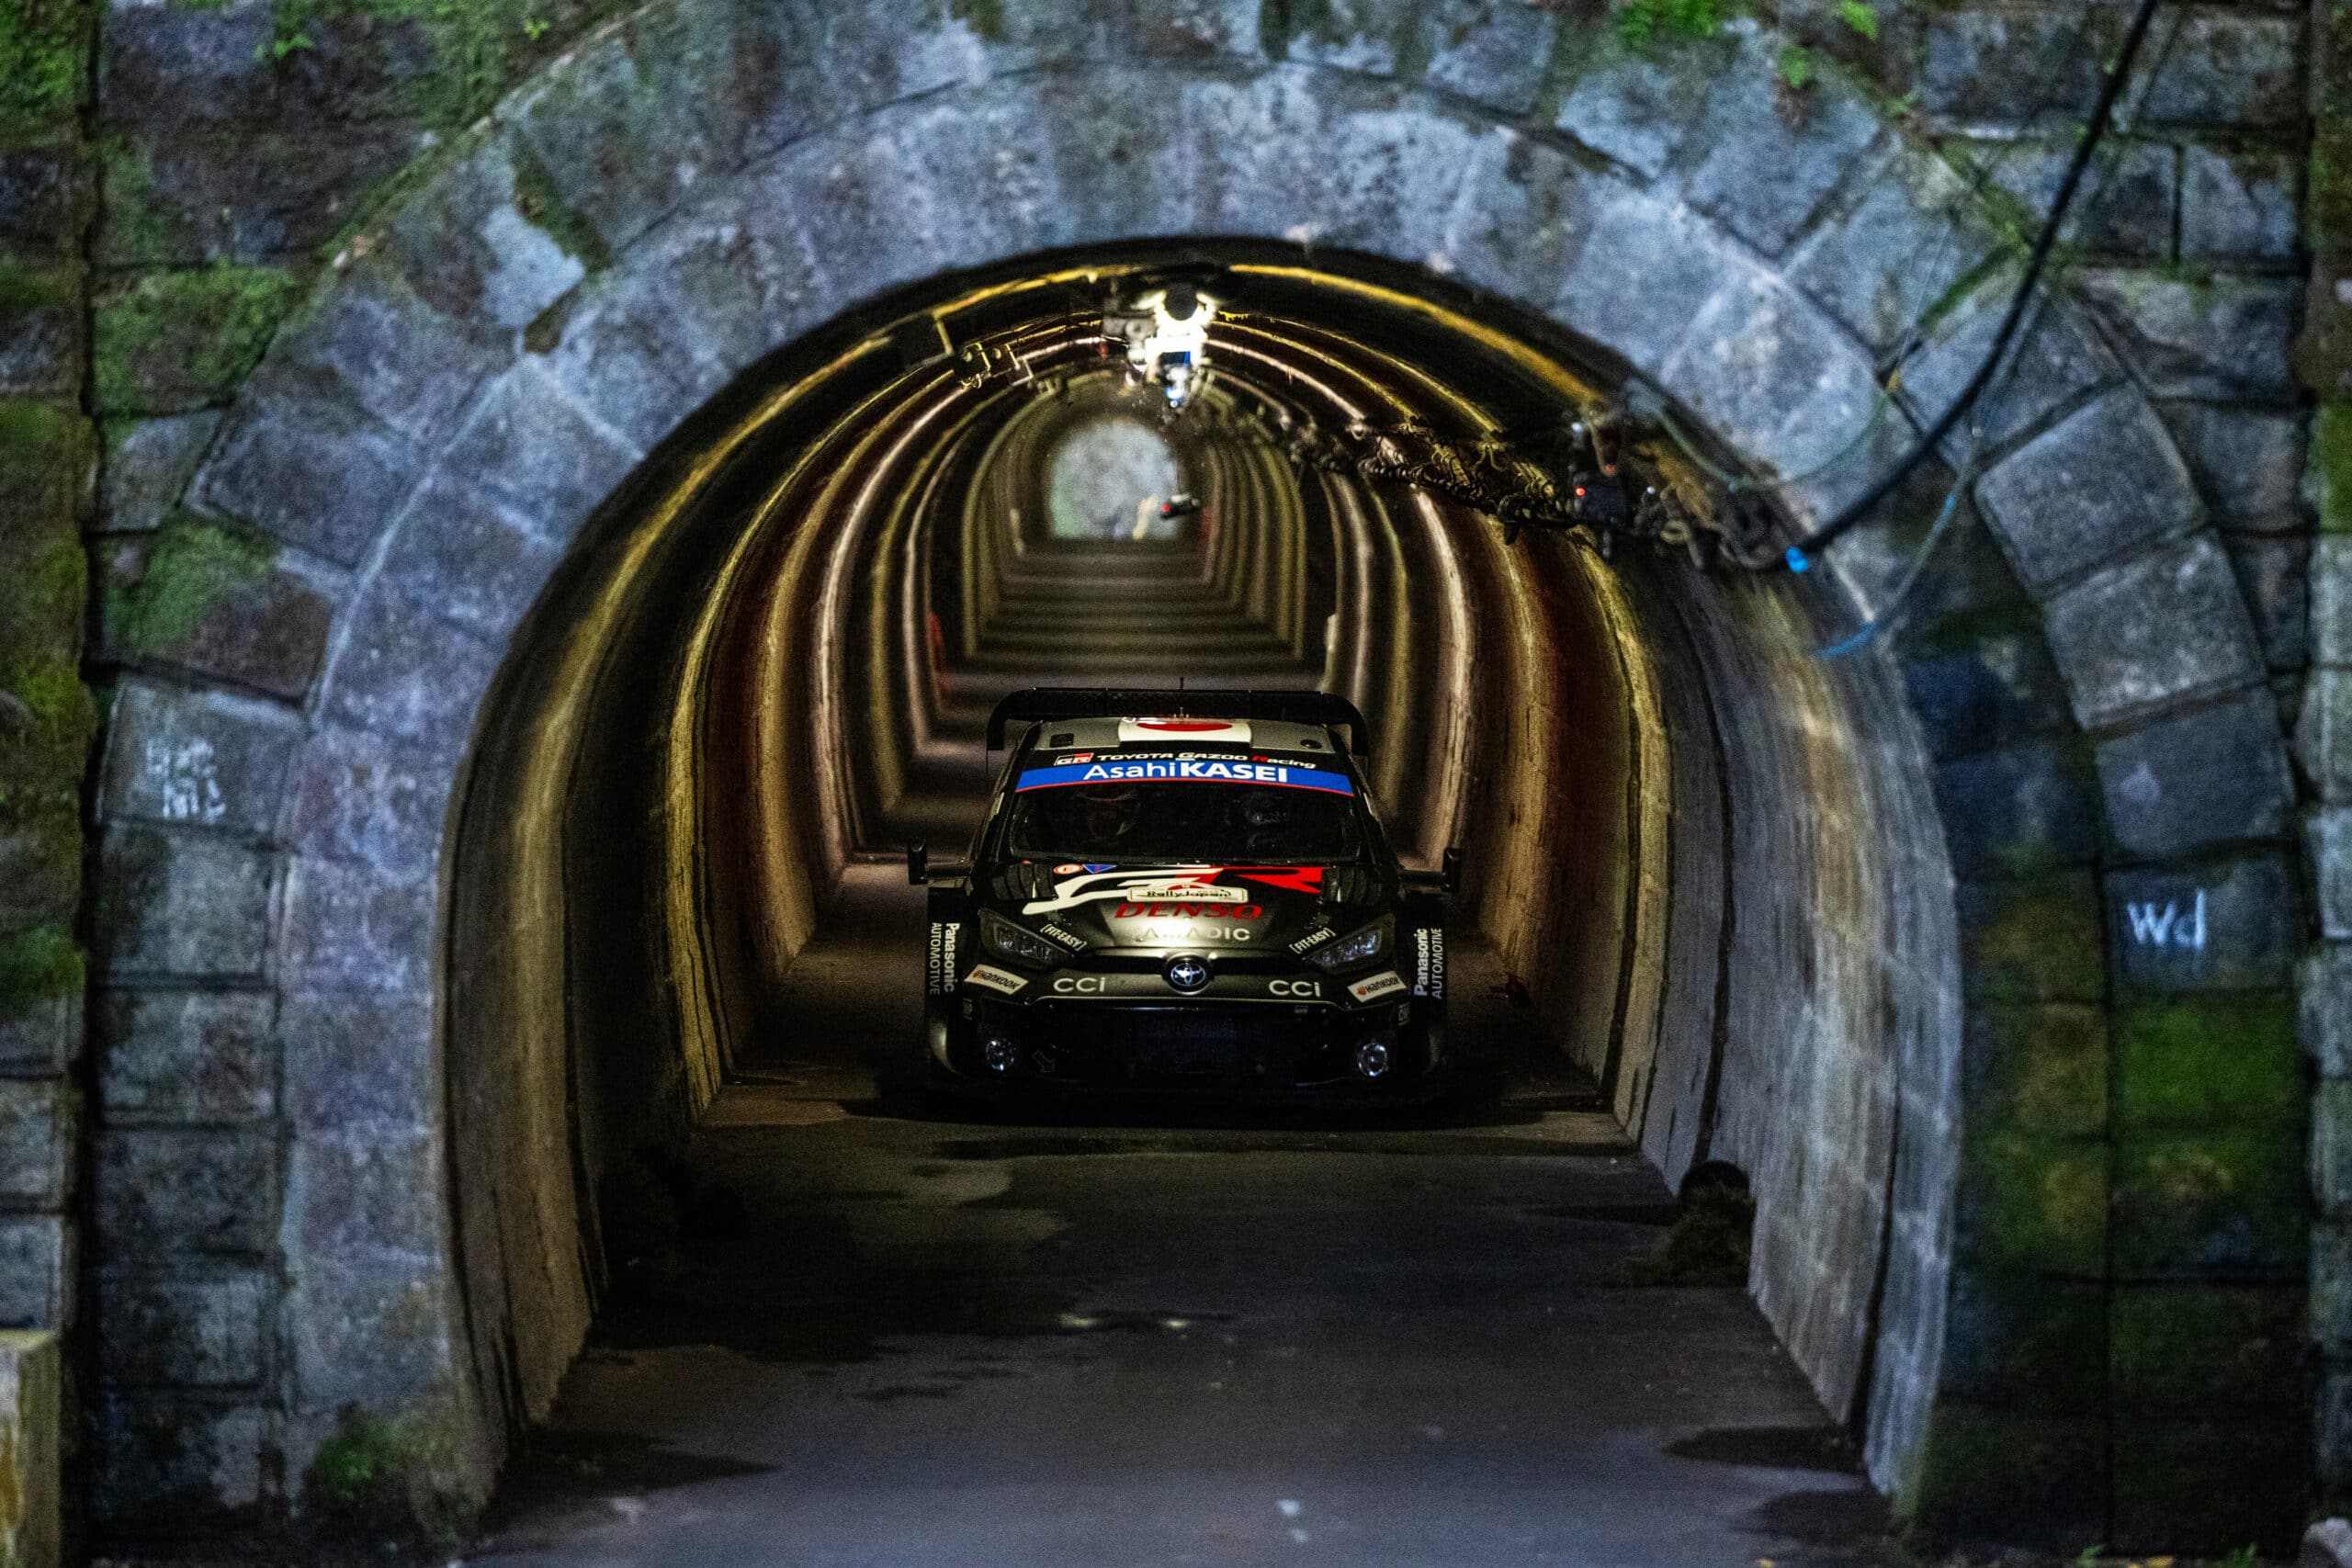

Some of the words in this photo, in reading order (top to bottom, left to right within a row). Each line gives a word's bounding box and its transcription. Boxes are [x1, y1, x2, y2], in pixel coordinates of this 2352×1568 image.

[1097, 753, 1174, 761] TOYOTA
[1176, 751, 1248, 761] GAZOO
[1251, 755, 1317, 769] Racing
[1114, 902, 1262, 919] DENSO
[929, 922, 943, 996] AUTOMOTIVE
[944, 922, 961, 993] Panasonic
[1413, 928, 1429, 997] Panasonic
[1430, 927, 1443, 999] AUTOMOTIVE
